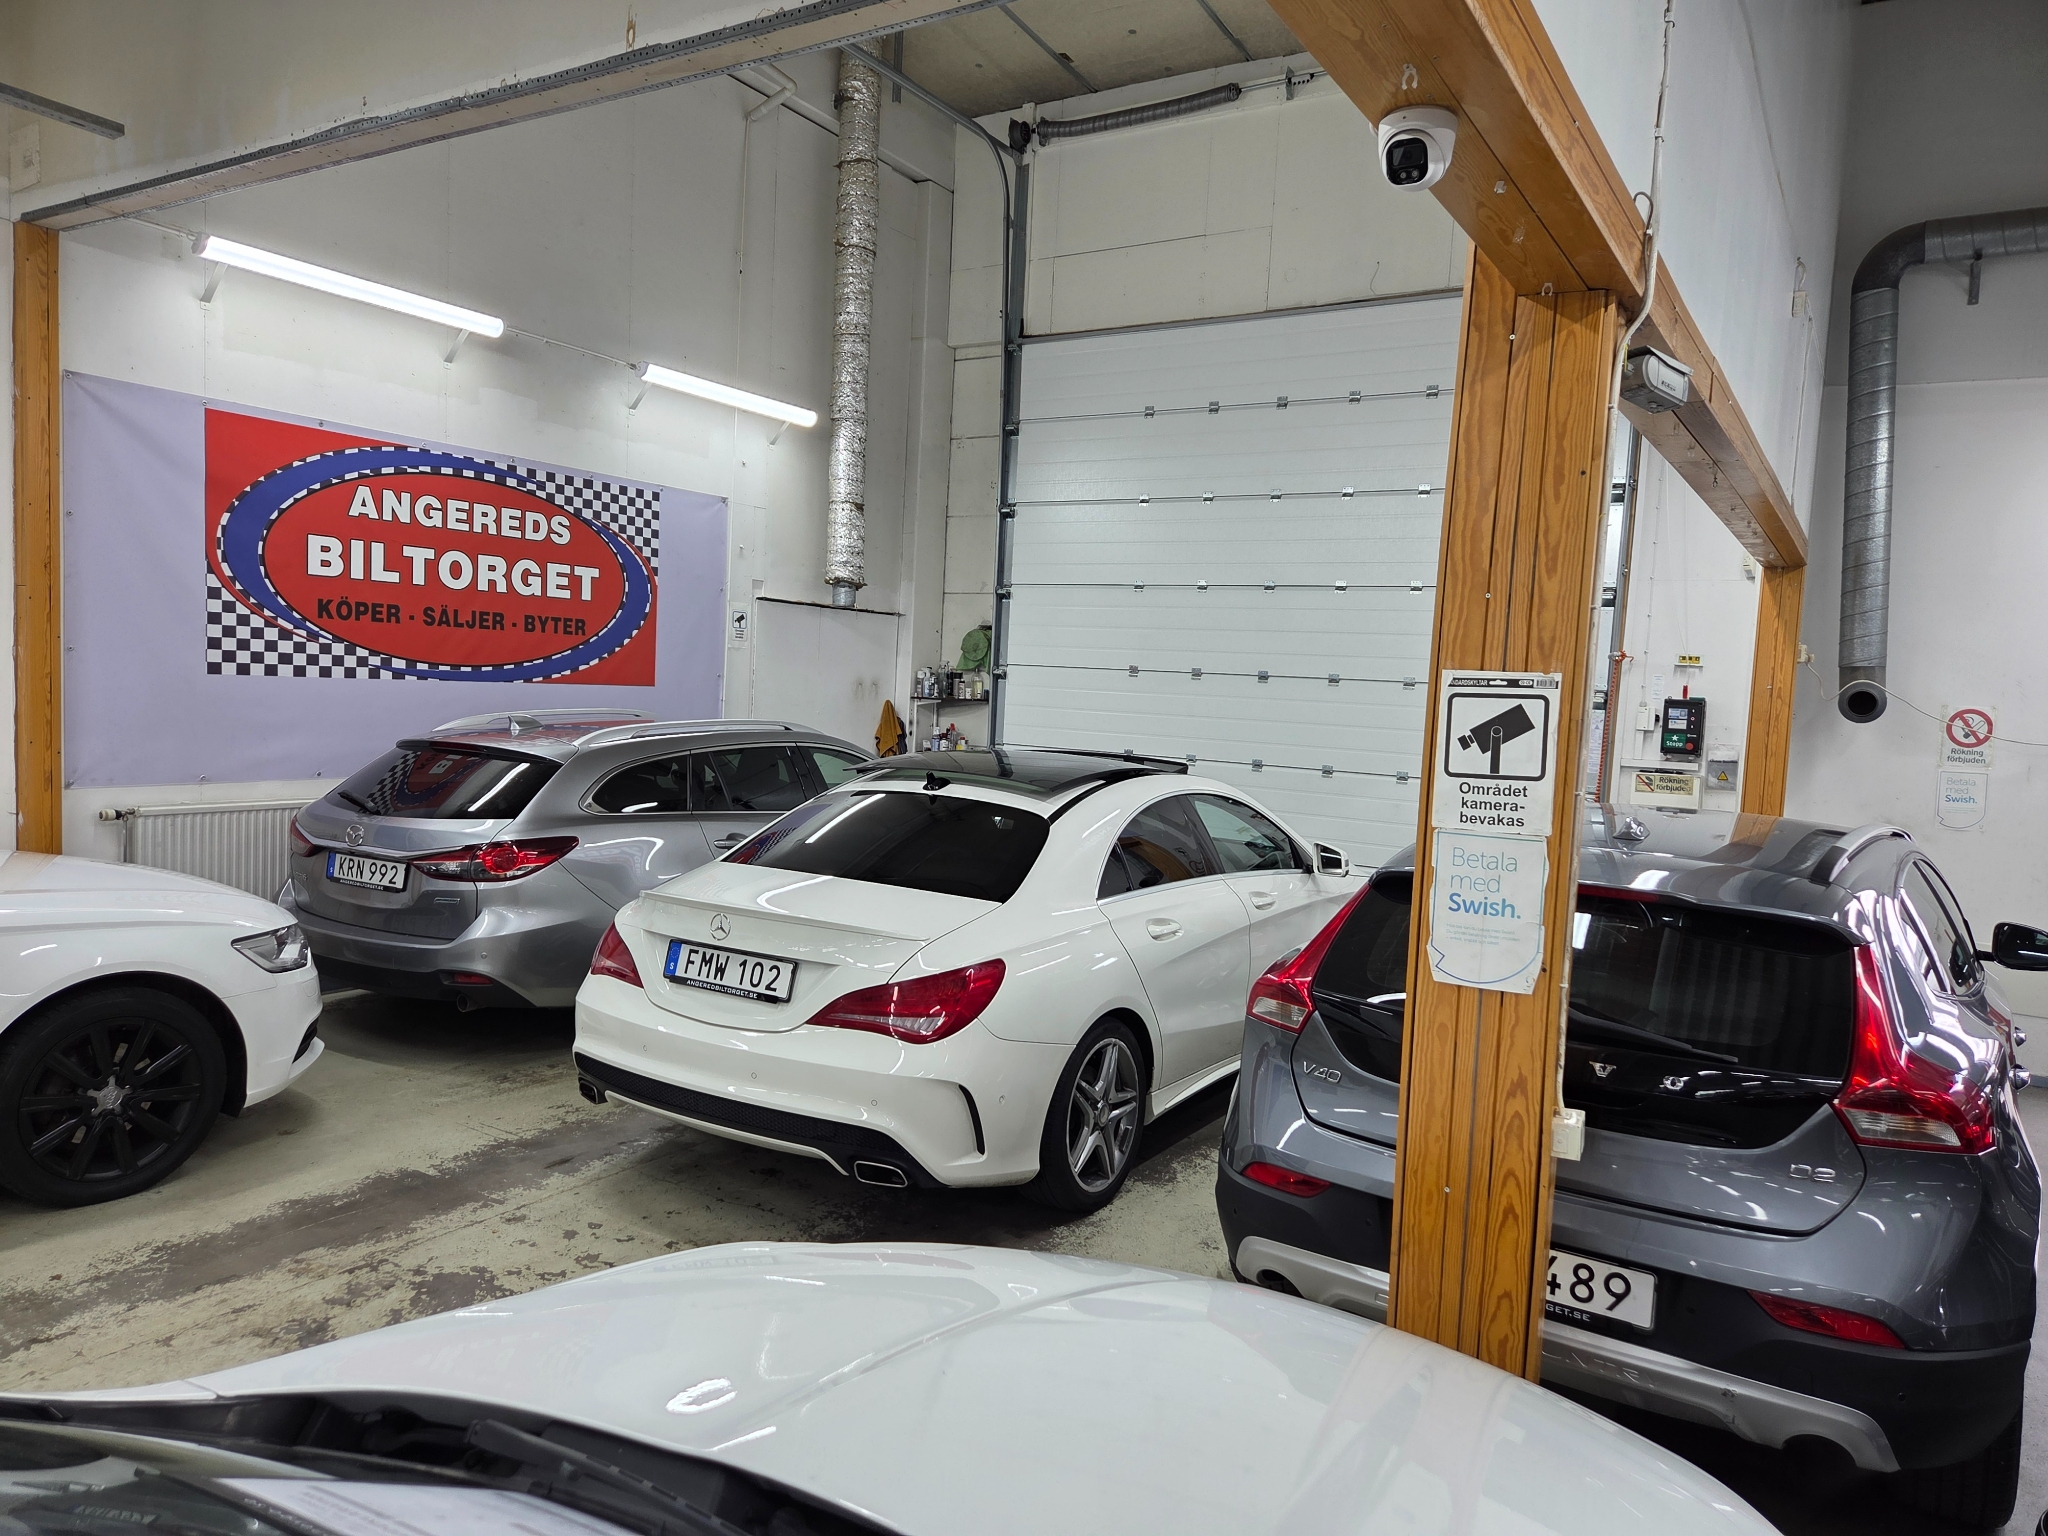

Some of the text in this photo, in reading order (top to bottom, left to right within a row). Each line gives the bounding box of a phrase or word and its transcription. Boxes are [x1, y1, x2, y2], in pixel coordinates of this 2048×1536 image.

[348, 484, 572, 546] ANGEREDS
[305, 533, 600, 602] BILTORGET
[316, 595, 587, 636] KÖPER SÄLJER BYTER
[1946, 755, 1986, 764] förbjuden
[1950, 747, 1984, 758] Rökning
[1459, 781, 1528, 797] Området
[1945, 786, 1969, 795] med
[1946, 776, 1976, 786] Betala
[1461, 796, 1526, 812] kamera-
[1459, 811, 1525, 827] bevakas
[338, 856, 399, 885] KRN 992
[1452, 847, 1518, 873] Betala
[1450, 872, 1501, 893] med
[1448, 893, 1522, 919] Swish.
[683, 948, 781, 992] FMW 102
[1303, 1060, 1342, 1084] V40
[1788, 1163, 1837, 1183] D2
